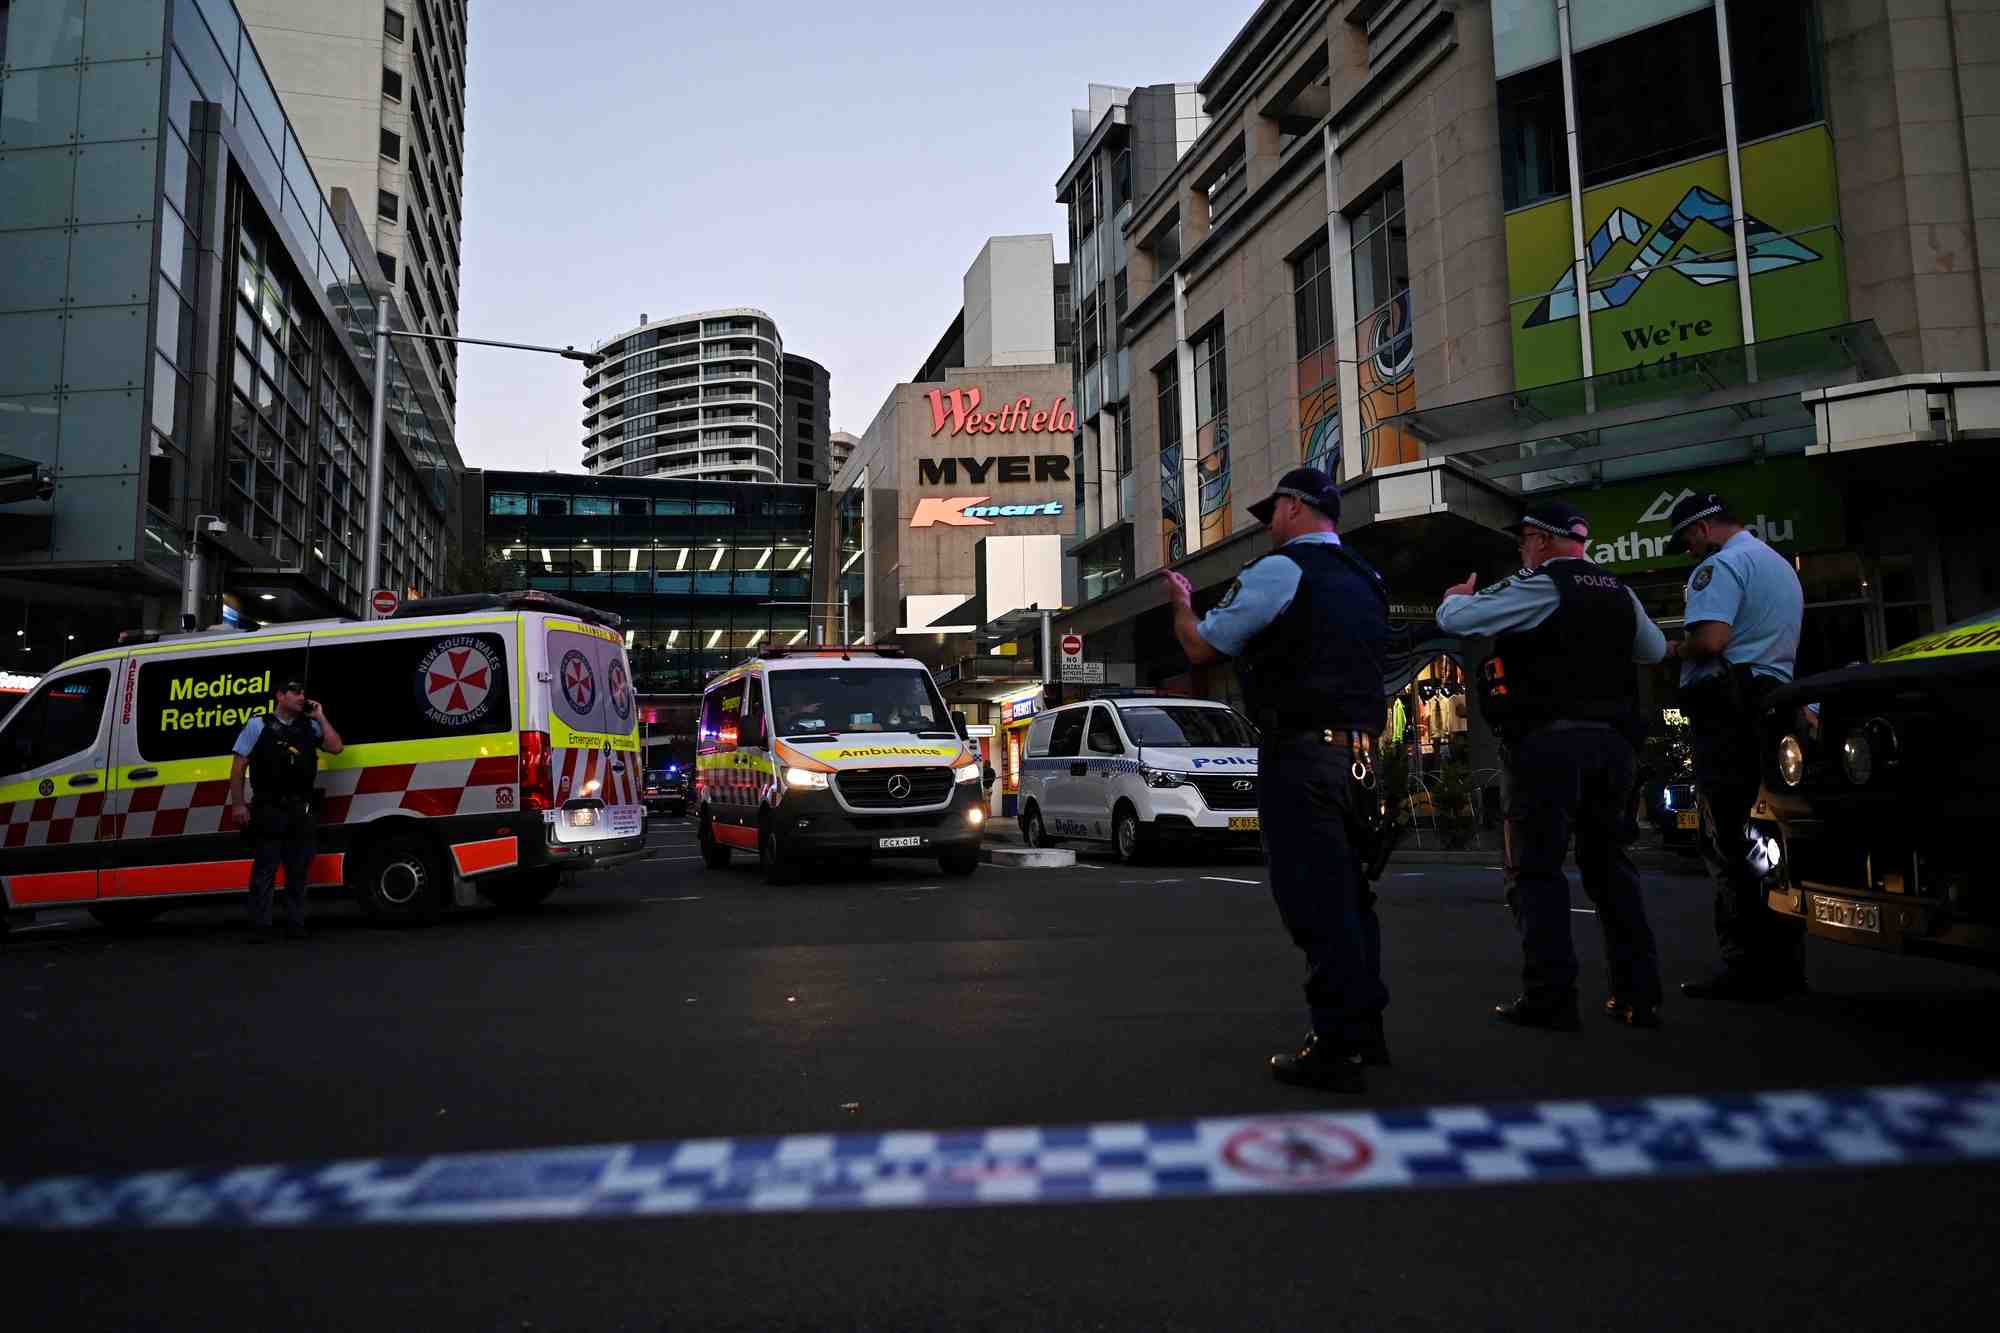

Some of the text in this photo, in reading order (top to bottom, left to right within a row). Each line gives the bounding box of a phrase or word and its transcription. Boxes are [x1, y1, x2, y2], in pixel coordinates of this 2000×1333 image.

[1622, 319, 1713, 351] We're
[919, 455, 1071, 485] MYER
[910, 496, 1064, 528] Kmart
[1574, 575, 1618, 588] POLICE
[417, 636, 501, 673] NEW SOUTH WALES
[170, 670, 271, 701] Medical
[160, 700, 275, 731] Retrieval
[424, 703, 489, 725] AMBULANCE
[569, 733, 600, 748] Emergency
[839, 747, 942, 758] Ambulance
[1192, 757, 1258, 768] Polic
